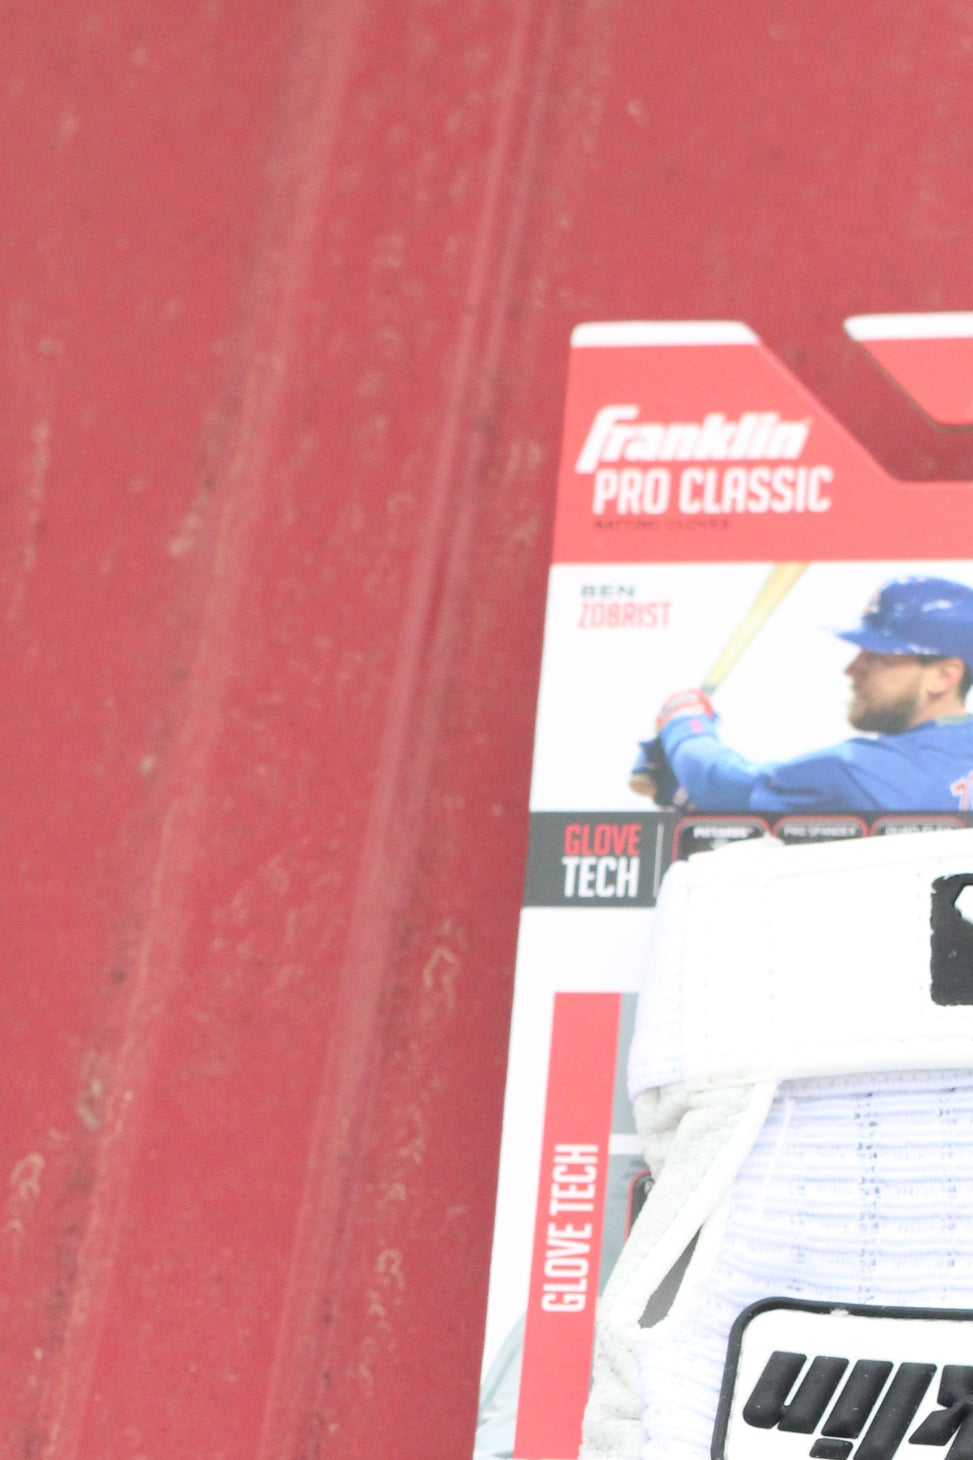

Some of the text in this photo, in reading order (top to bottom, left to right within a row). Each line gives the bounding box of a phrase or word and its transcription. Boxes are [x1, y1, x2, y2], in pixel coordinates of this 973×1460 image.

[575, 404, 810, 473] franklin
[592, 467, 833, 515] PRO CLASSIC
[581, 584, 636, 598] BEN
[577, 602, 671, 629] ZOBRIST
[564, 823, 641, 856] GLOVE
[562, 856, 640, 898] TECH
[541, 1143, 599, 1313] GLOVE TECH
